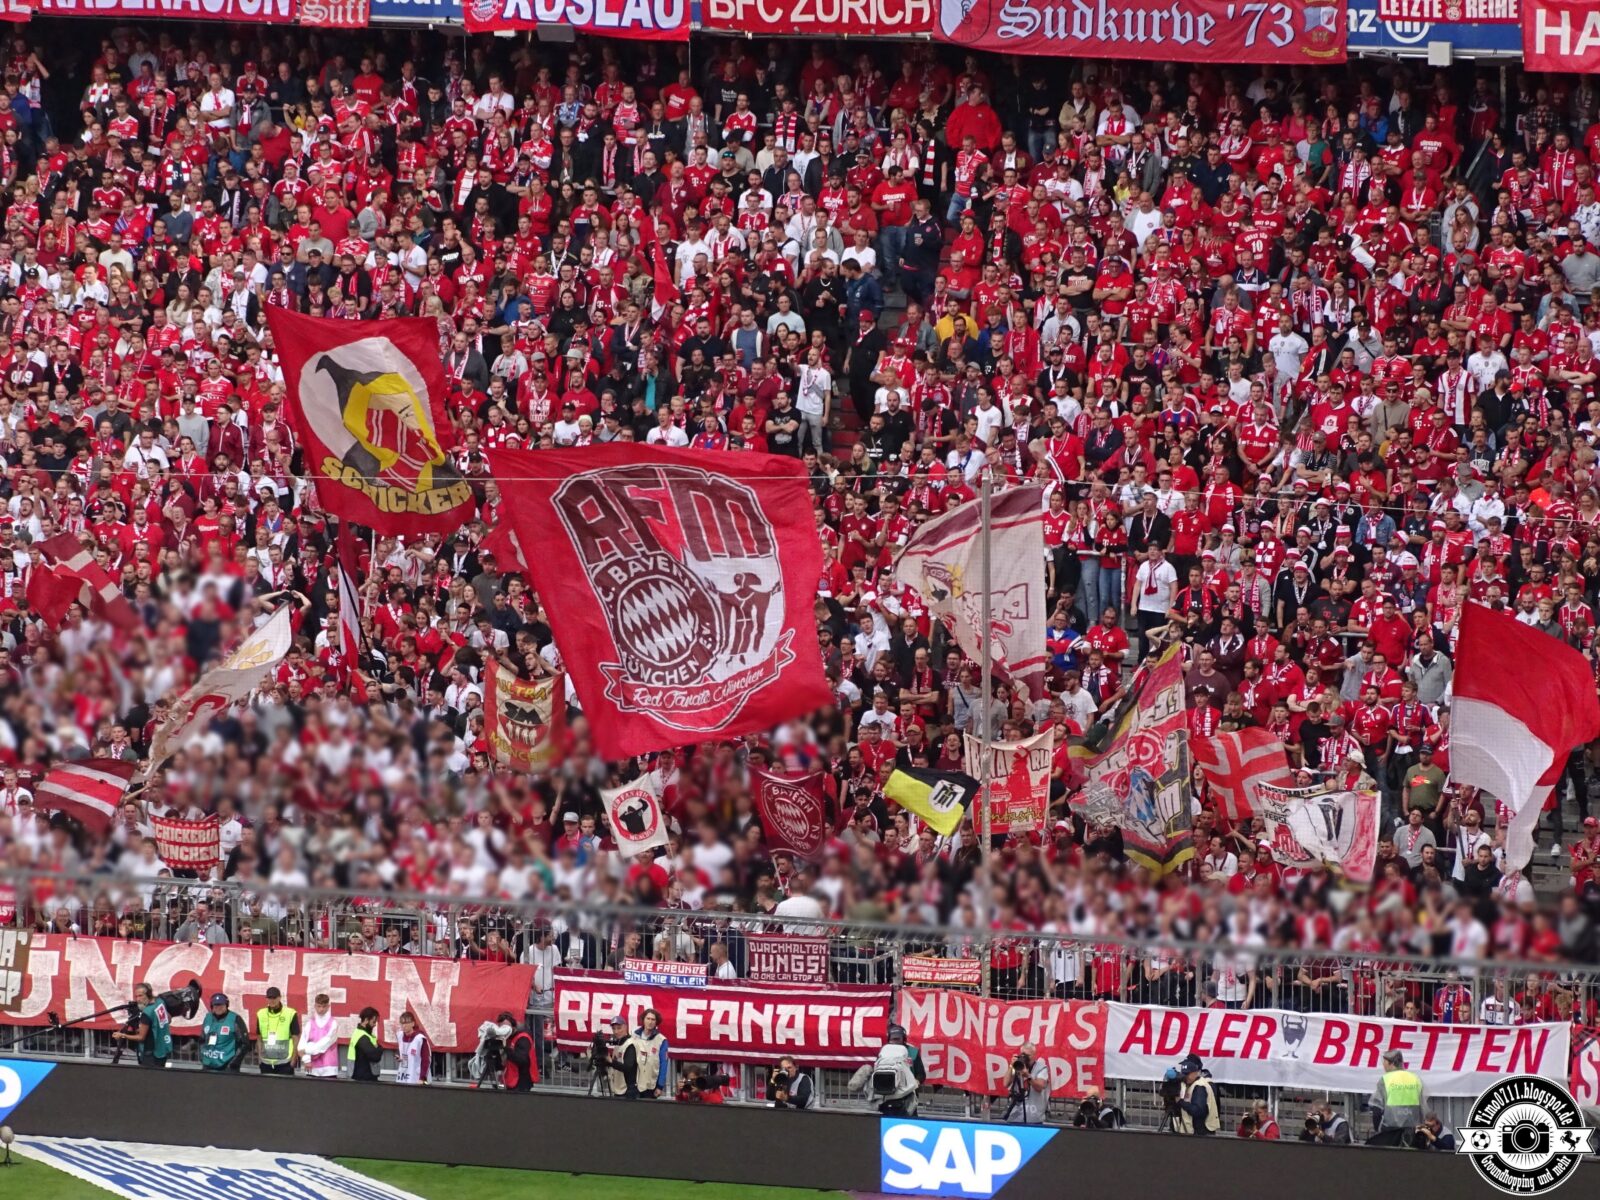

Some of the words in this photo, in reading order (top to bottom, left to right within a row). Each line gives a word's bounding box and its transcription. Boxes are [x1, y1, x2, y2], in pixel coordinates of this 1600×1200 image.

[750, 953, 826, 974] JUNGS!
[921, 1043, 972, 1083] ED
[986, 1053, 1098, 1093] PDE
[1120, 1008, 1277, 1060] ADLER
[1313, 1020, 1549, 1074] BRETTEN
[883, 1124, 1022, 1193] SAP
